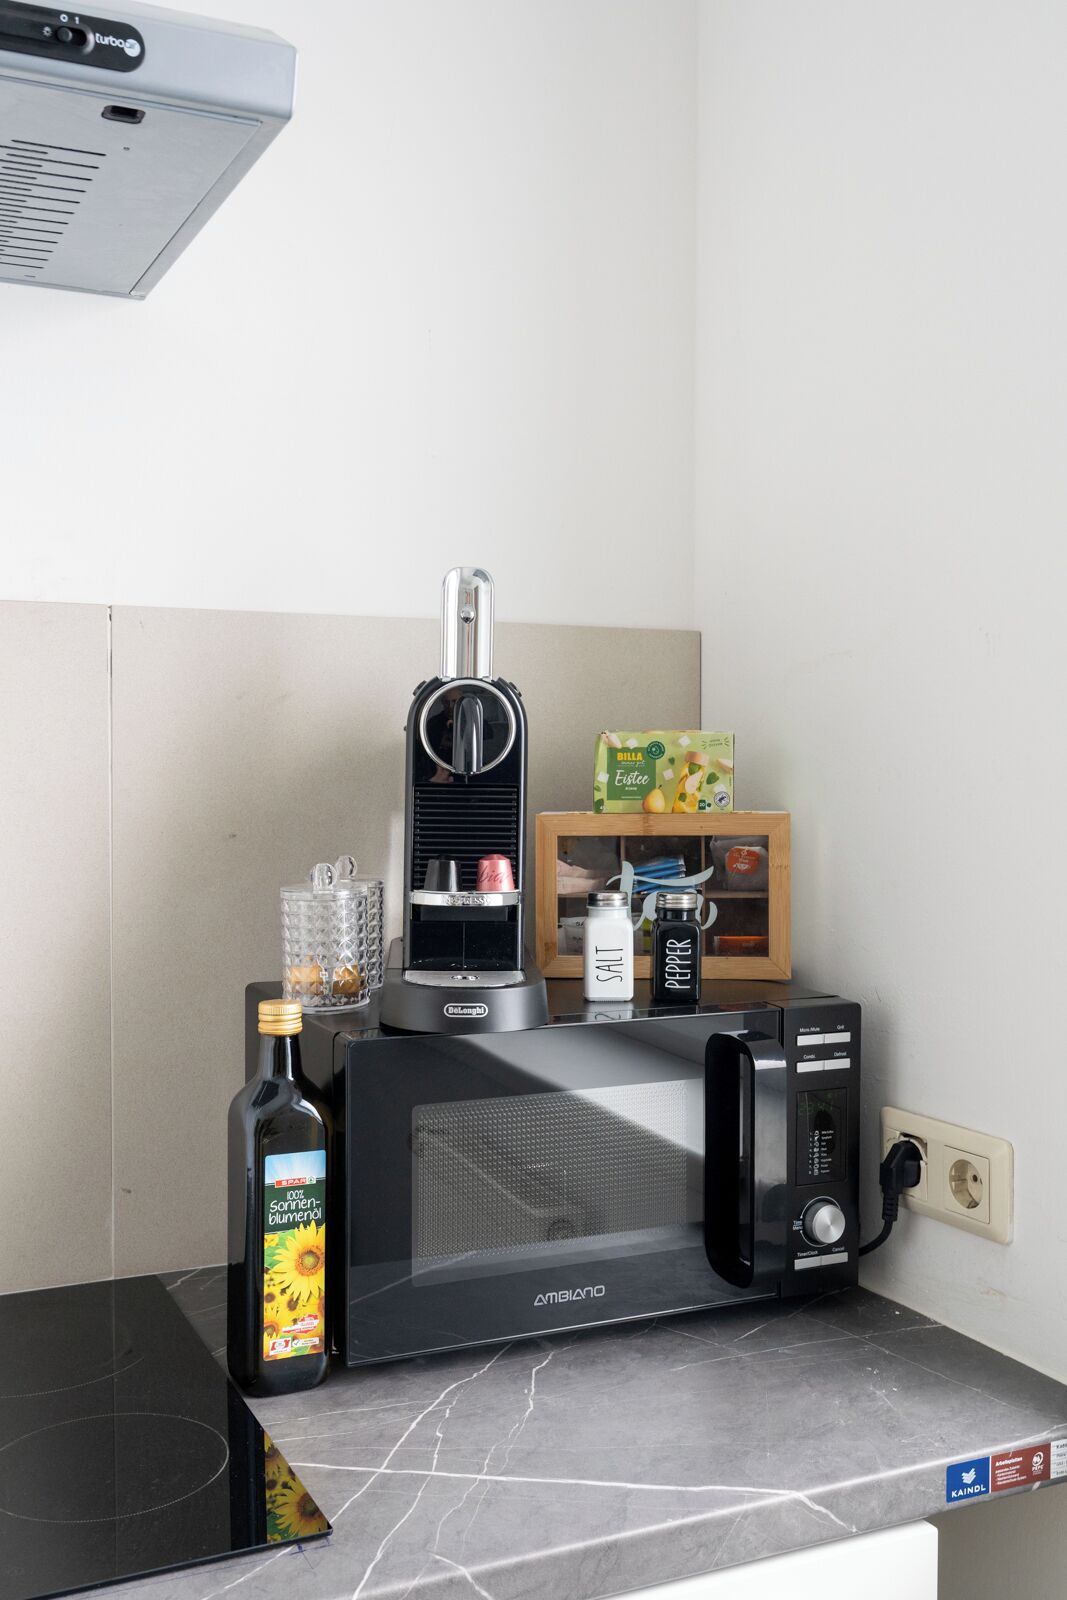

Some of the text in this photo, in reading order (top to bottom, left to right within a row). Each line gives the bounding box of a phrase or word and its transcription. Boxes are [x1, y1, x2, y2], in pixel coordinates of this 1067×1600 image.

[616, 752, 643, 761] BILLA
[614, 769, 650, 786] Eistee
[595, 945, 624, 983] SALT
[664, 938, 692, 989] PEPPER
[280, 1177, 307, 1187] SPAR
[286, 1189, 305, 1201] 100%
[269, 1197, 321, 1213] Sonnen-
[268, 1207, 322, 1226] blumenöl
[533, 1284, 606, 1307] AMBIANO
[951, 1484, 987, 1499] KAINDL
